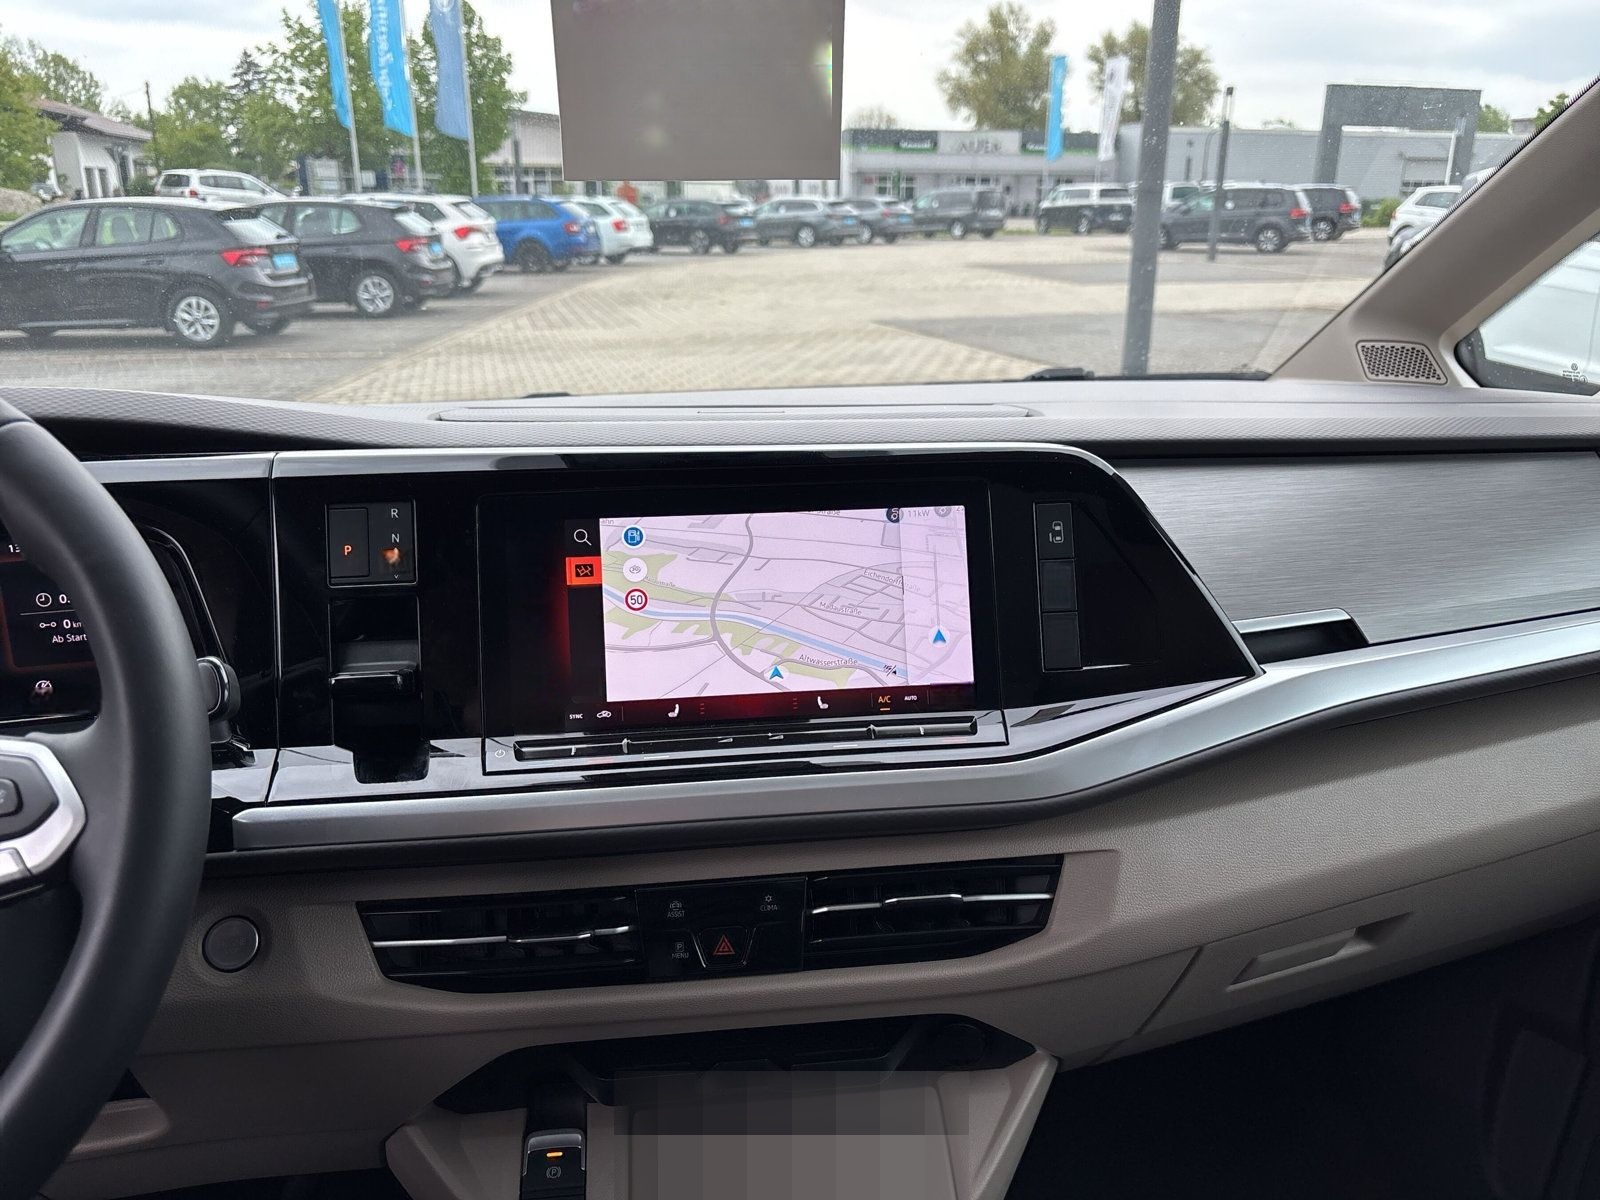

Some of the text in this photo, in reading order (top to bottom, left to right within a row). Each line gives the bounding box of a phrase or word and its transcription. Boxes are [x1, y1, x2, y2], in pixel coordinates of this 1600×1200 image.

[391, 508, 399, 518] R
[907, 510, 930, 518] 11kW
[391, 533, 400, 543] N
[344, 545, 352, 556] P
[630, 595, 643, 606] 50
[52, 633, 88, 643] Ab Start
[799, 653, 858, 667] Altwasserstraße
[878, 695, 891, 703] A/C
